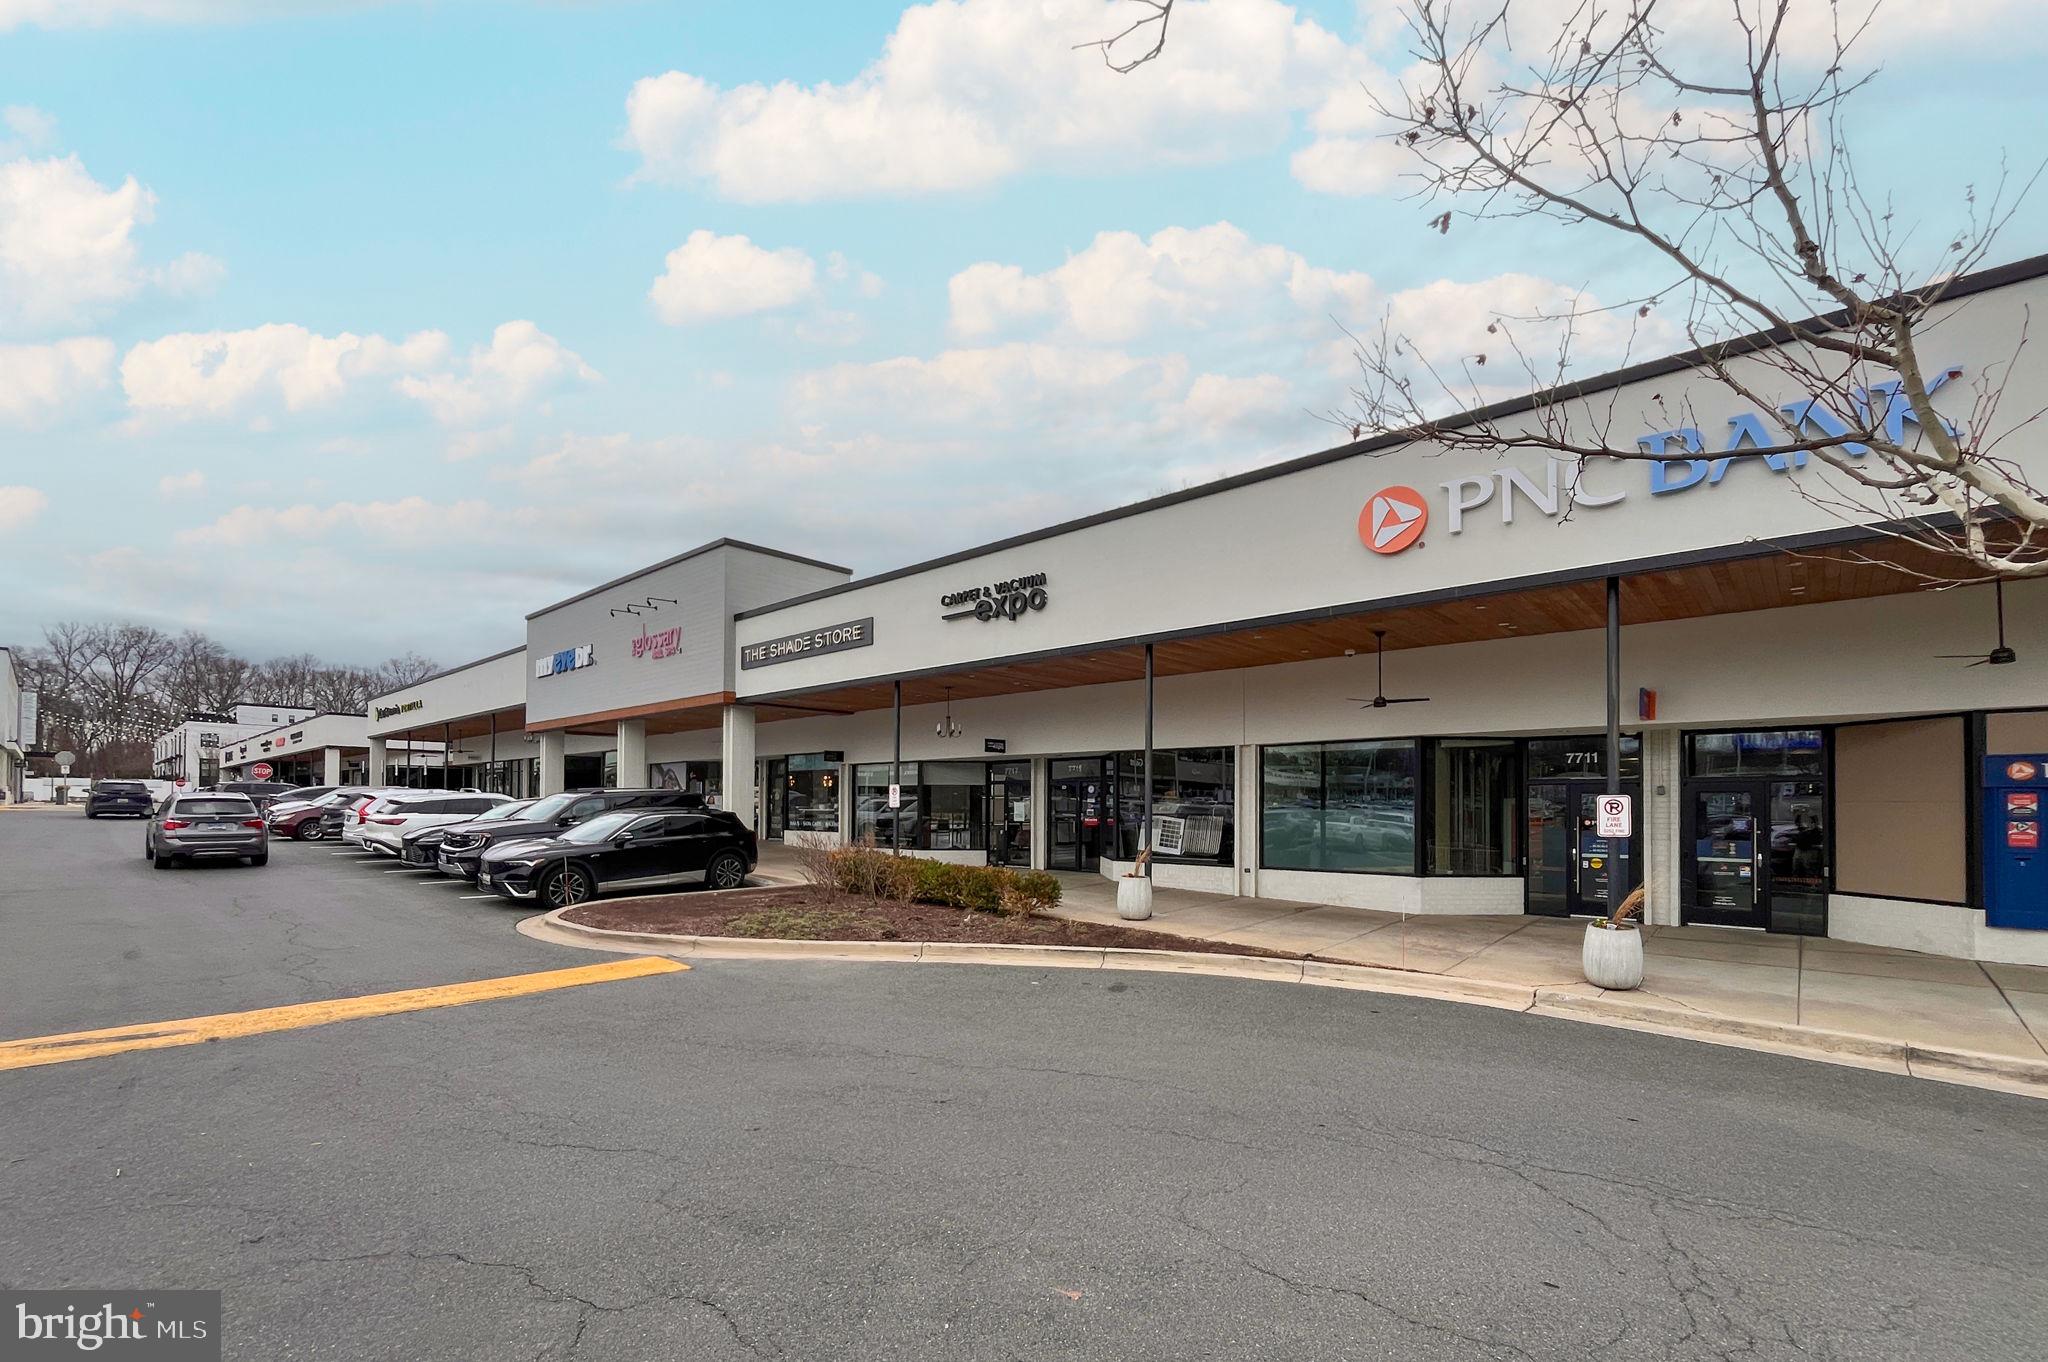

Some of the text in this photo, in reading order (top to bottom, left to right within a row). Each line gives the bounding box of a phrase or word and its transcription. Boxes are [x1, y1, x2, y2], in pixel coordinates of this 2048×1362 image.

[1439, 365, 1966, 536] PNC BANK
[940, 572, 1048, 607] CARPET & VACUUM
[973, 586, 1048, 621] expo
[744, 624, 864, 663] THE SHADE STORE
[254, 767, 271, 775] STOP
[1565, 751, 1599, 764] 7711
